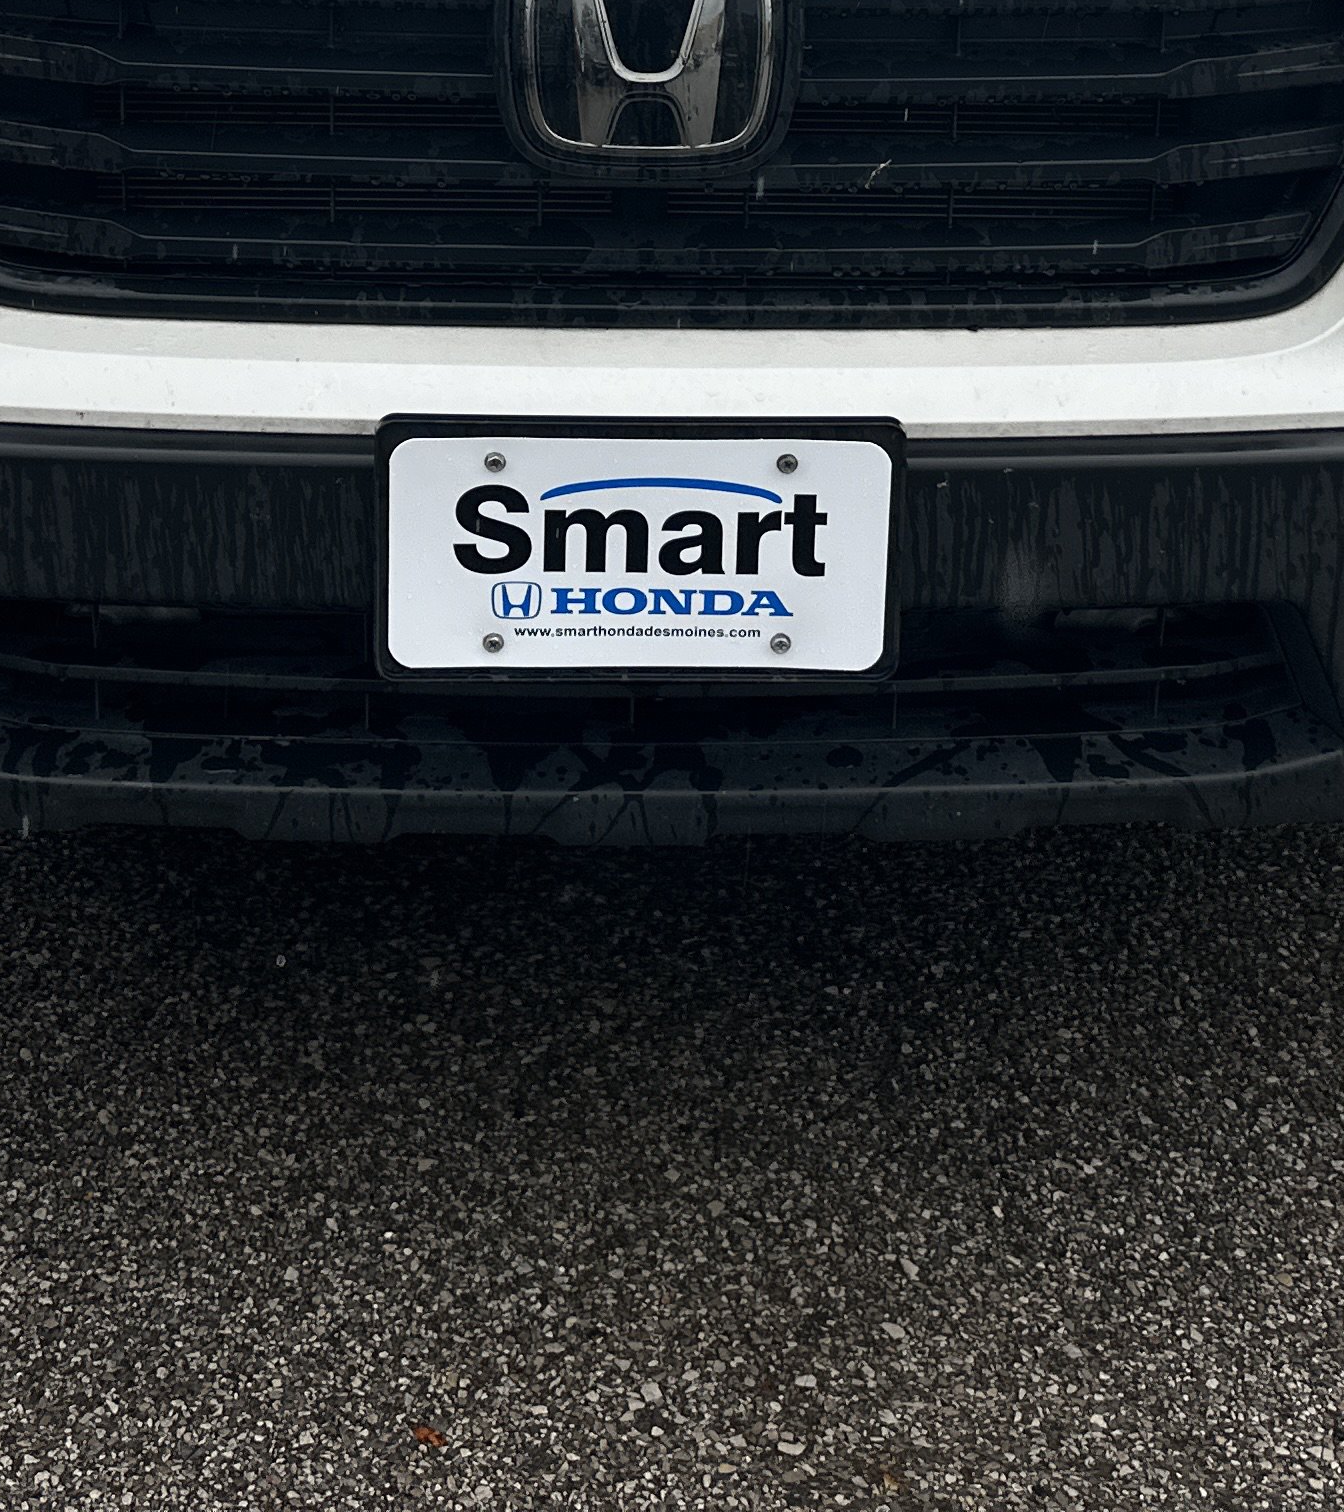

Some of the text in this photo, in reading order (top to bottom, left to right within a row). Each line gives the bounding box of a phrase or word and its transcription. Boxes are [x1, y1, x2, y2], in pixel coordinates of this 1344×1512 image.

[452, 484, 828, 577] Smart
[550, 587, 794, 617] HONDA
[514, 625, 761, 638] www.smarthondadesmoines.com
